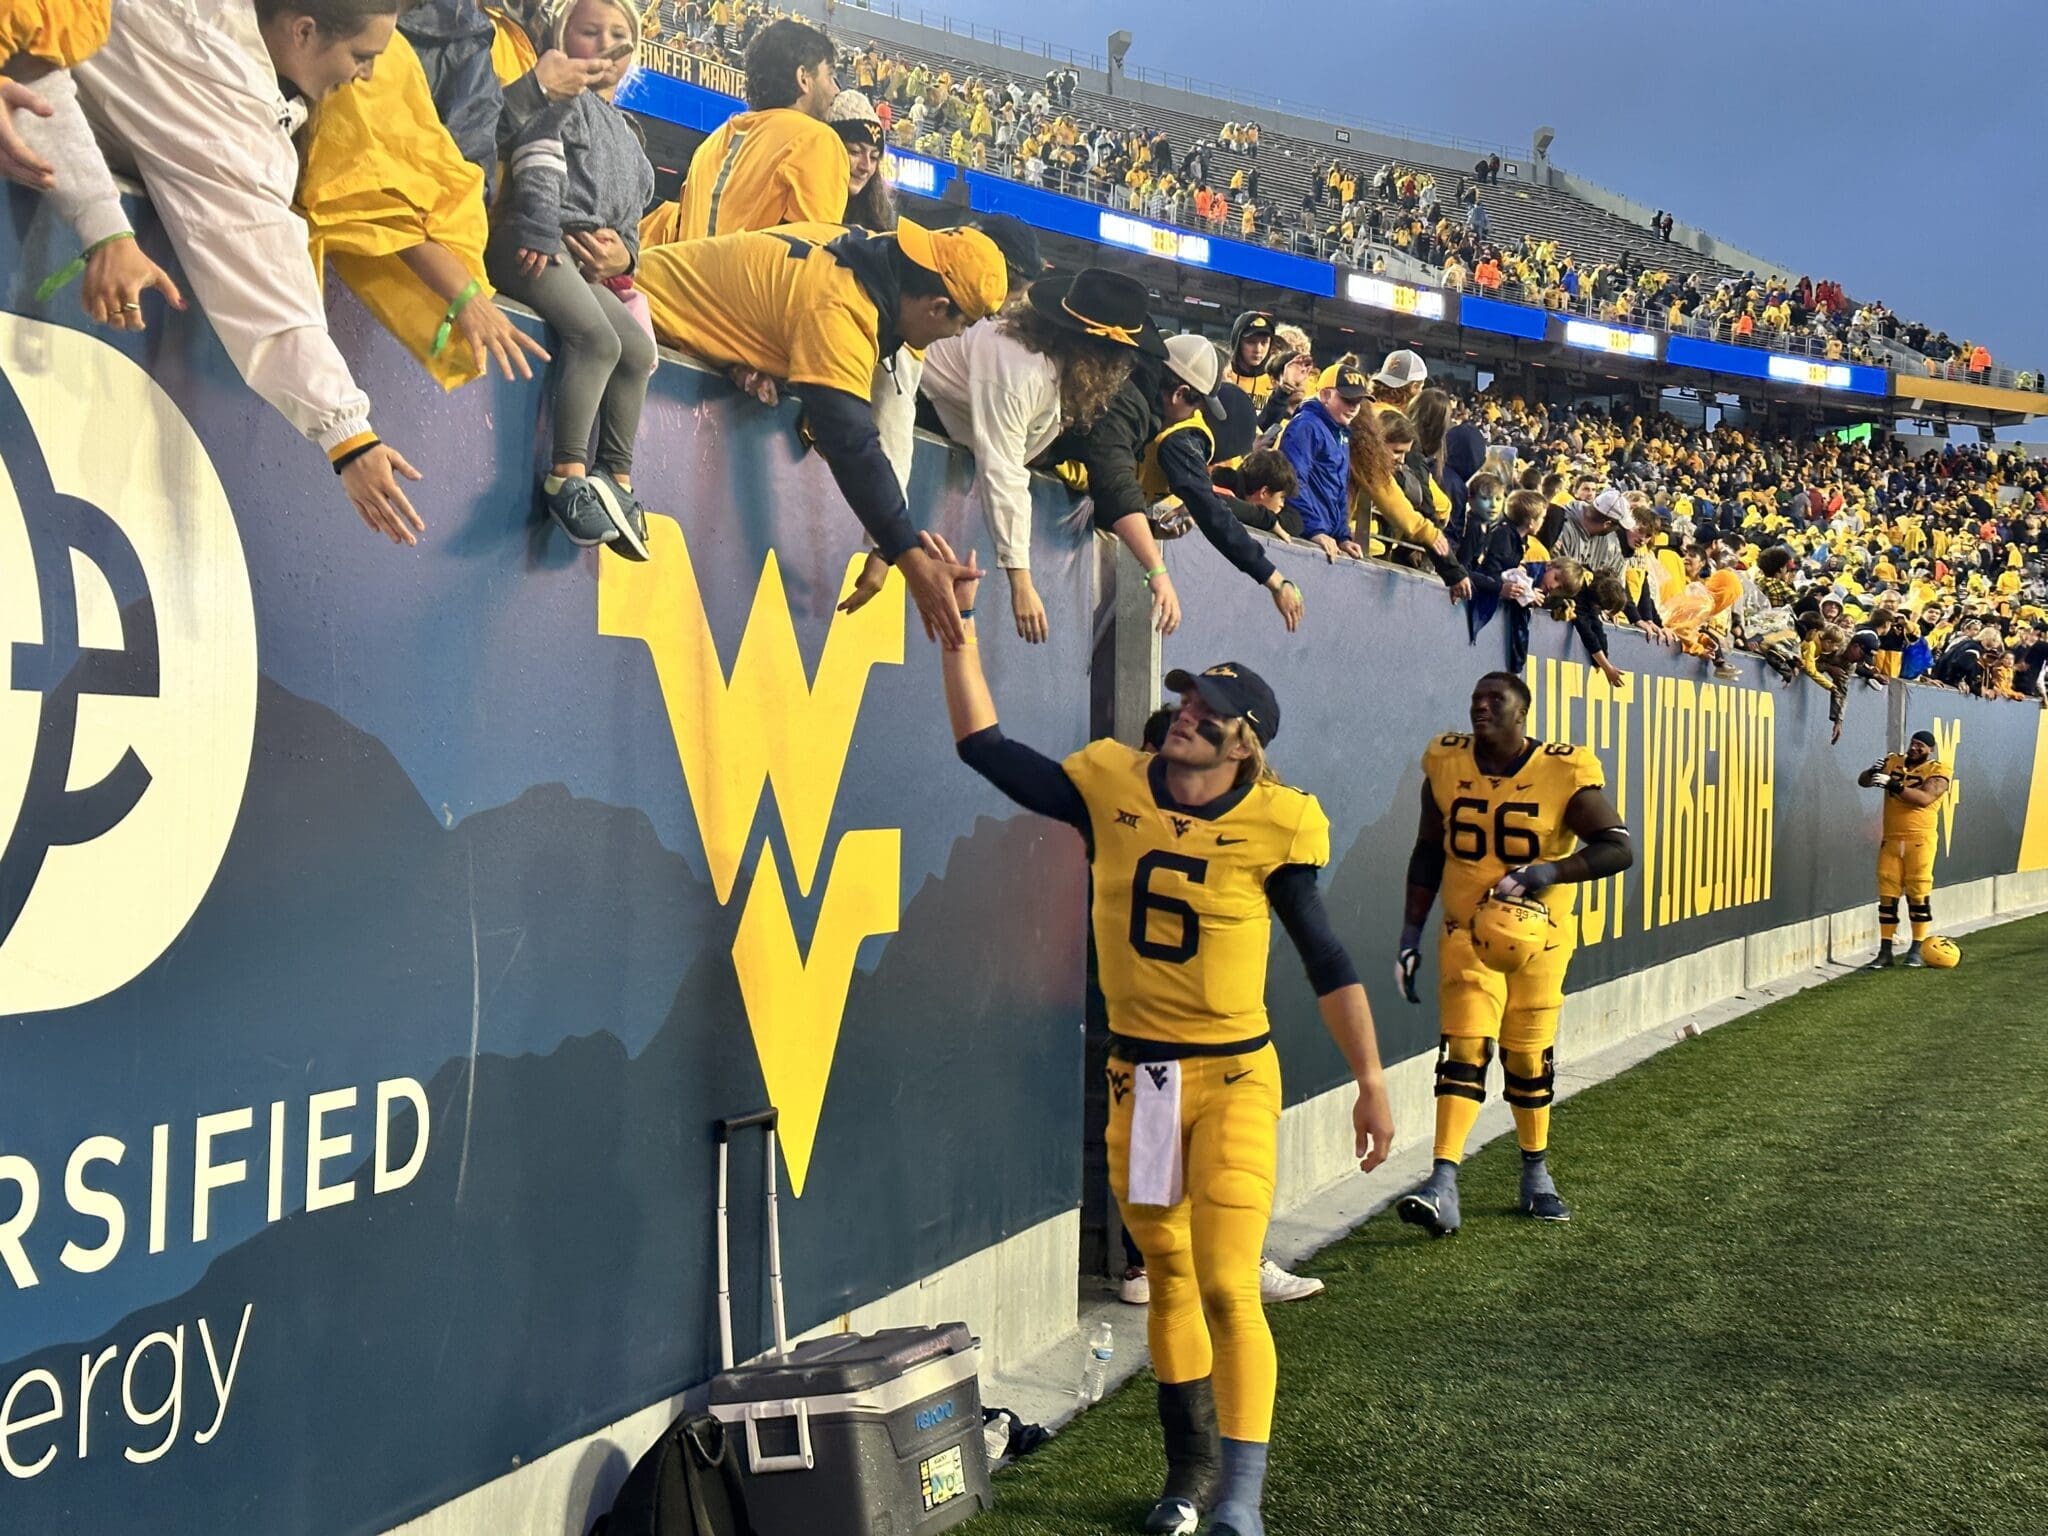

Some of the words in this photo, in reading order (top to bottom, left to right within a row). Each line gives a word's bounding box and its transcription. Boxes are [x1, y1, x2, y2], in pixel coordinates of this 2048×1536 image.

[1450, 796, 1540, 864] 66
[1643, 674, 1775, 931] VIRGINIA
[1129, 849, 1208, 964] 6
[0, 1077, 430, 1289] RSIFIED
[0, 1303, 253, 1478] ergy
